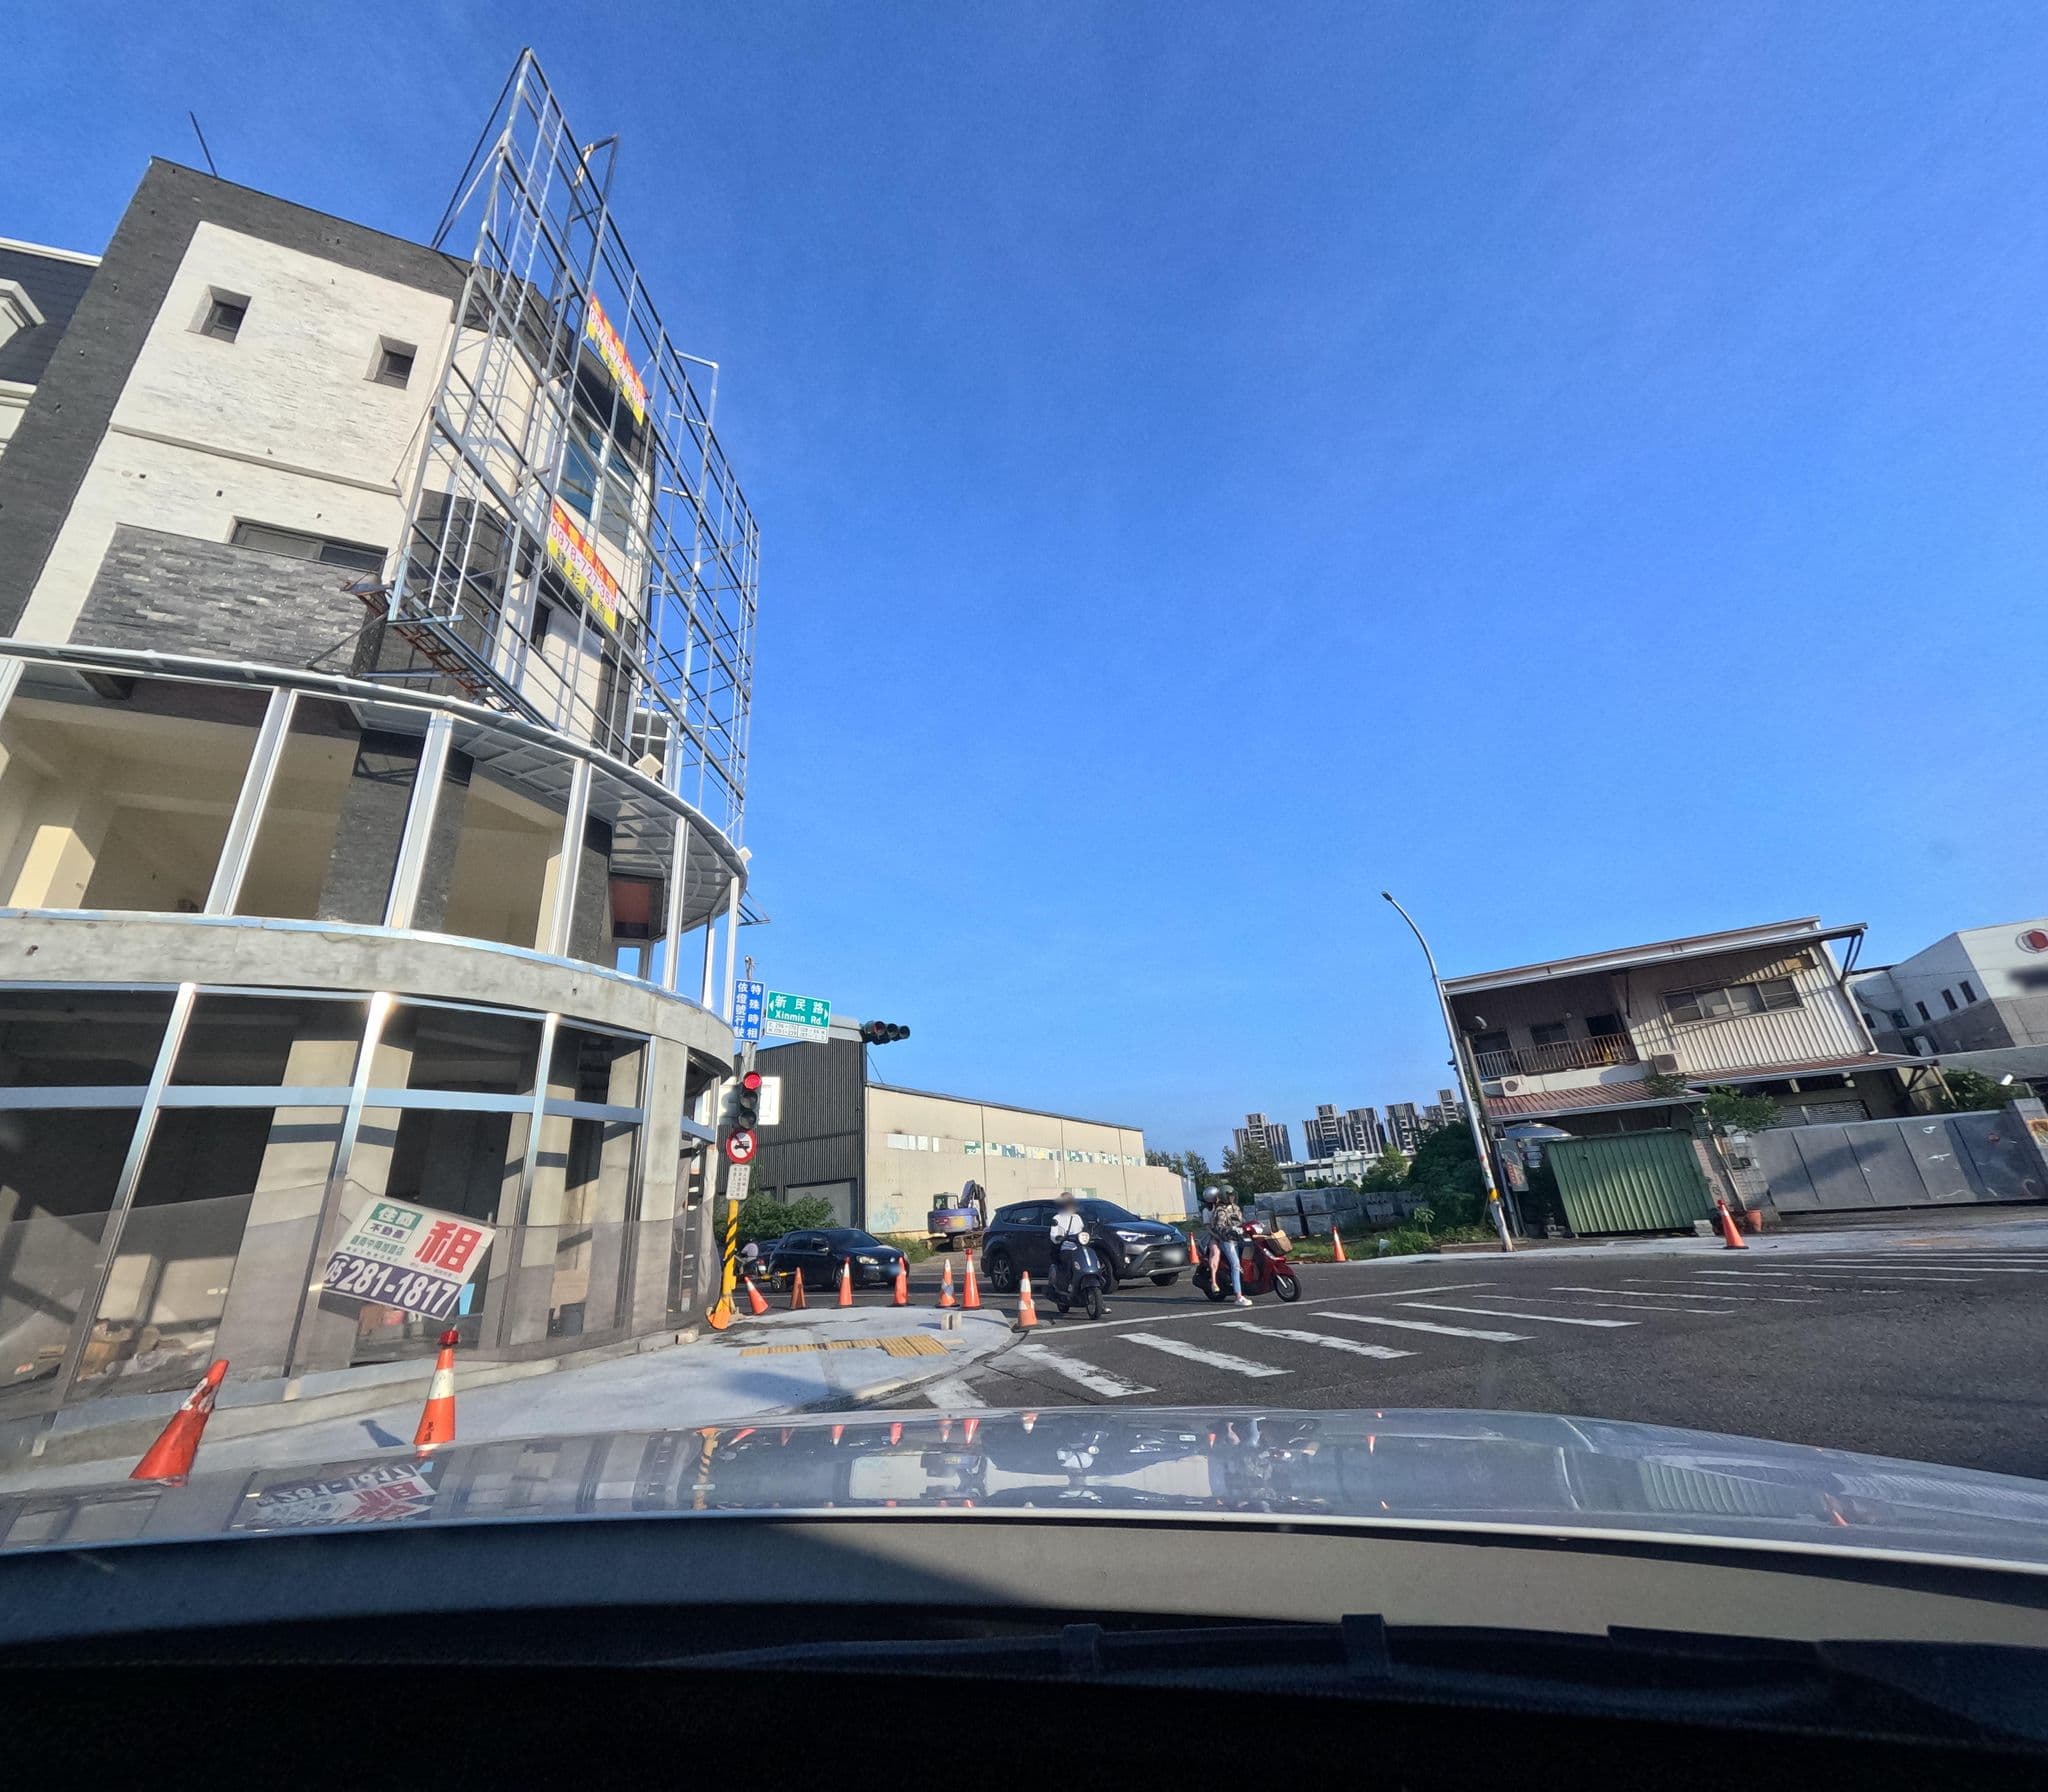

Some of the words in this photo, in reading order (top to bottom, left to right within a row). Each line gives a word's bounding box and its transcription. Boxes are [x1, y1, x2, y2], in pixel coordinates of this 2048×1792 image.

[551, 522, 616, 612] 0978-727-355
[733, 982, 748, 1037] 依燈號行駛
[747, 984, 761, 1038] 特殊時相
[774, 1010, 806, 1023] Xinmin
[811, 1015, 823, 1025] Rd.
[775, 994, 823, 1014] 新民路
[414, 1220, 483, 1273] 租
